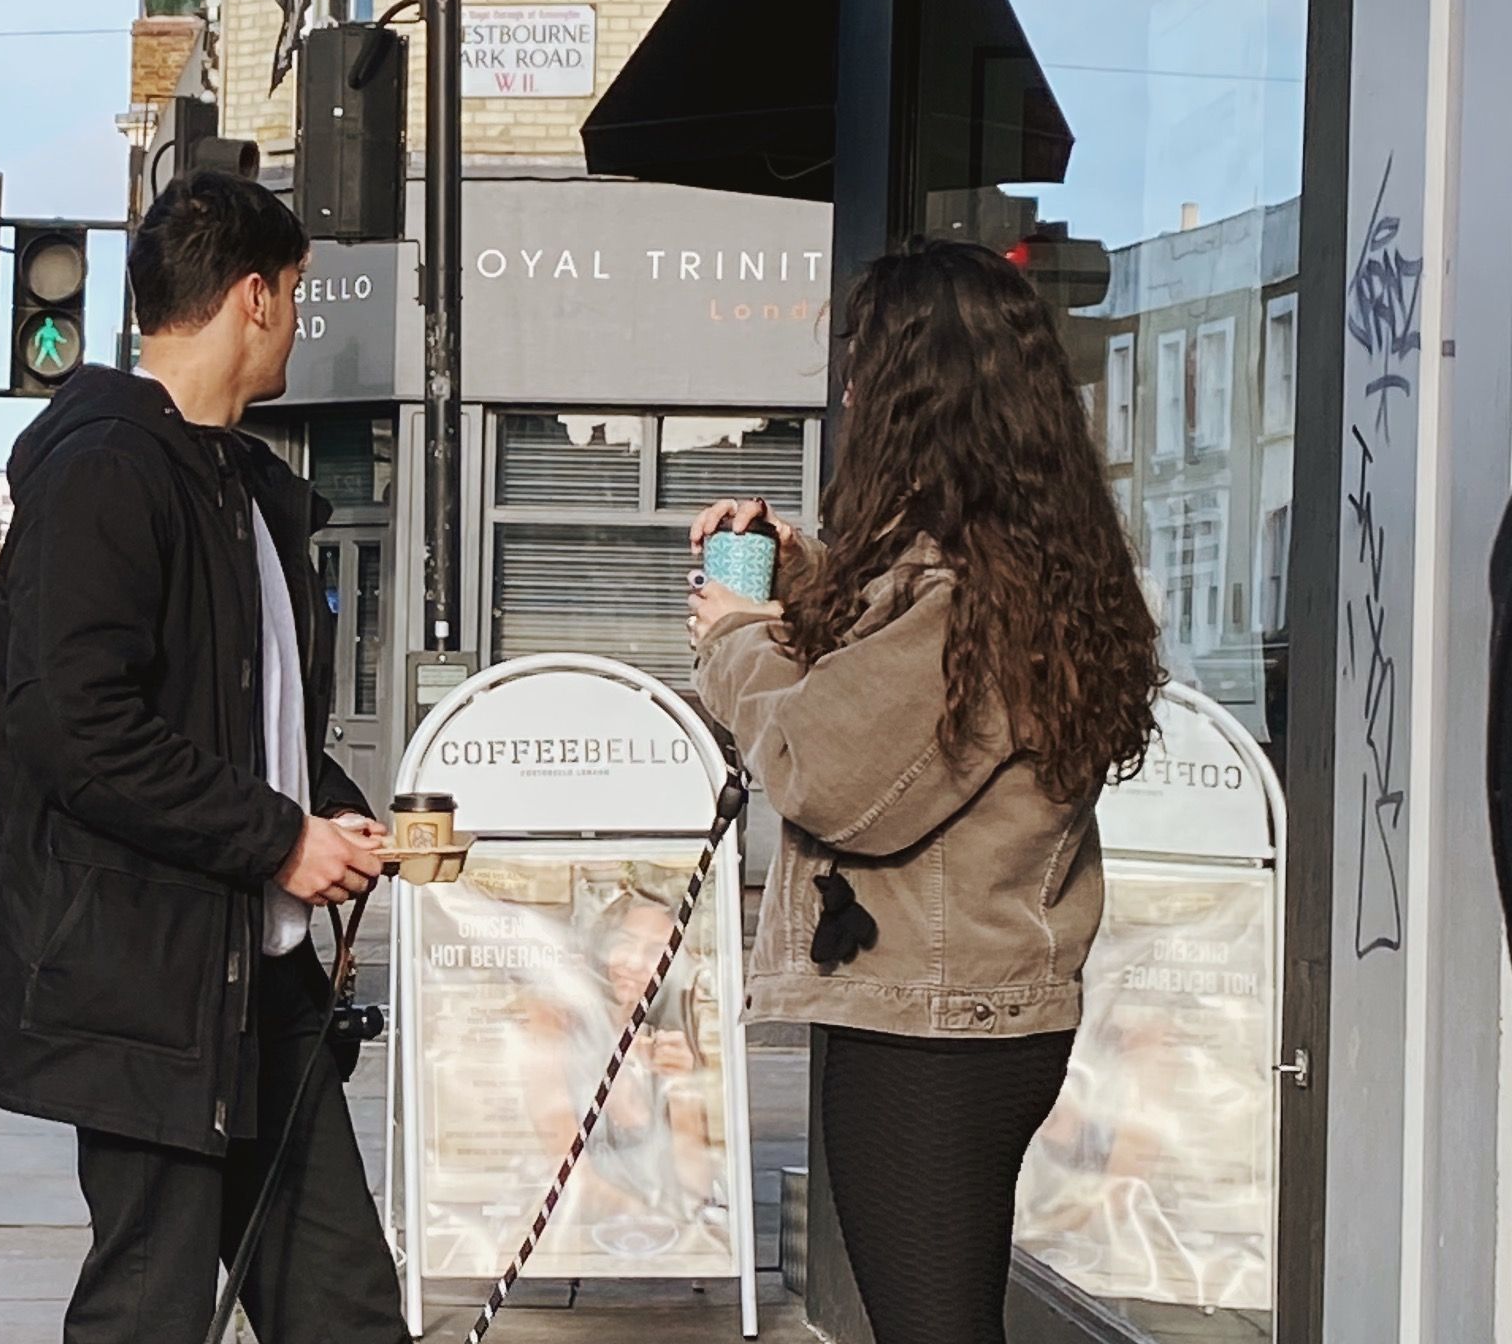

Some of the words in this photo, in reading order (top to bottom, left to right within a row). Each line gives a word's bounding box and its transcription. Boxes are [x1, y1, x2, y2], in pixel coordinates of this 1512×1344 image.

[461, 24, 590, 44] ESTBOURNE
[461, 48, 505, 68] ARK
[476, 249, 610, 279] OYAL
[646, 251, 823, 281] TRINIT
[294, 274, 372, 303] BELLO
[709, 299, 810, 321] Lond
[294, 316, 325, 339] AD
[441, 738, 689, 766] COFFEEBELLO
[430, 944, 466, 968] HOT
[470, 945, 564, 969] BEVERAGE
